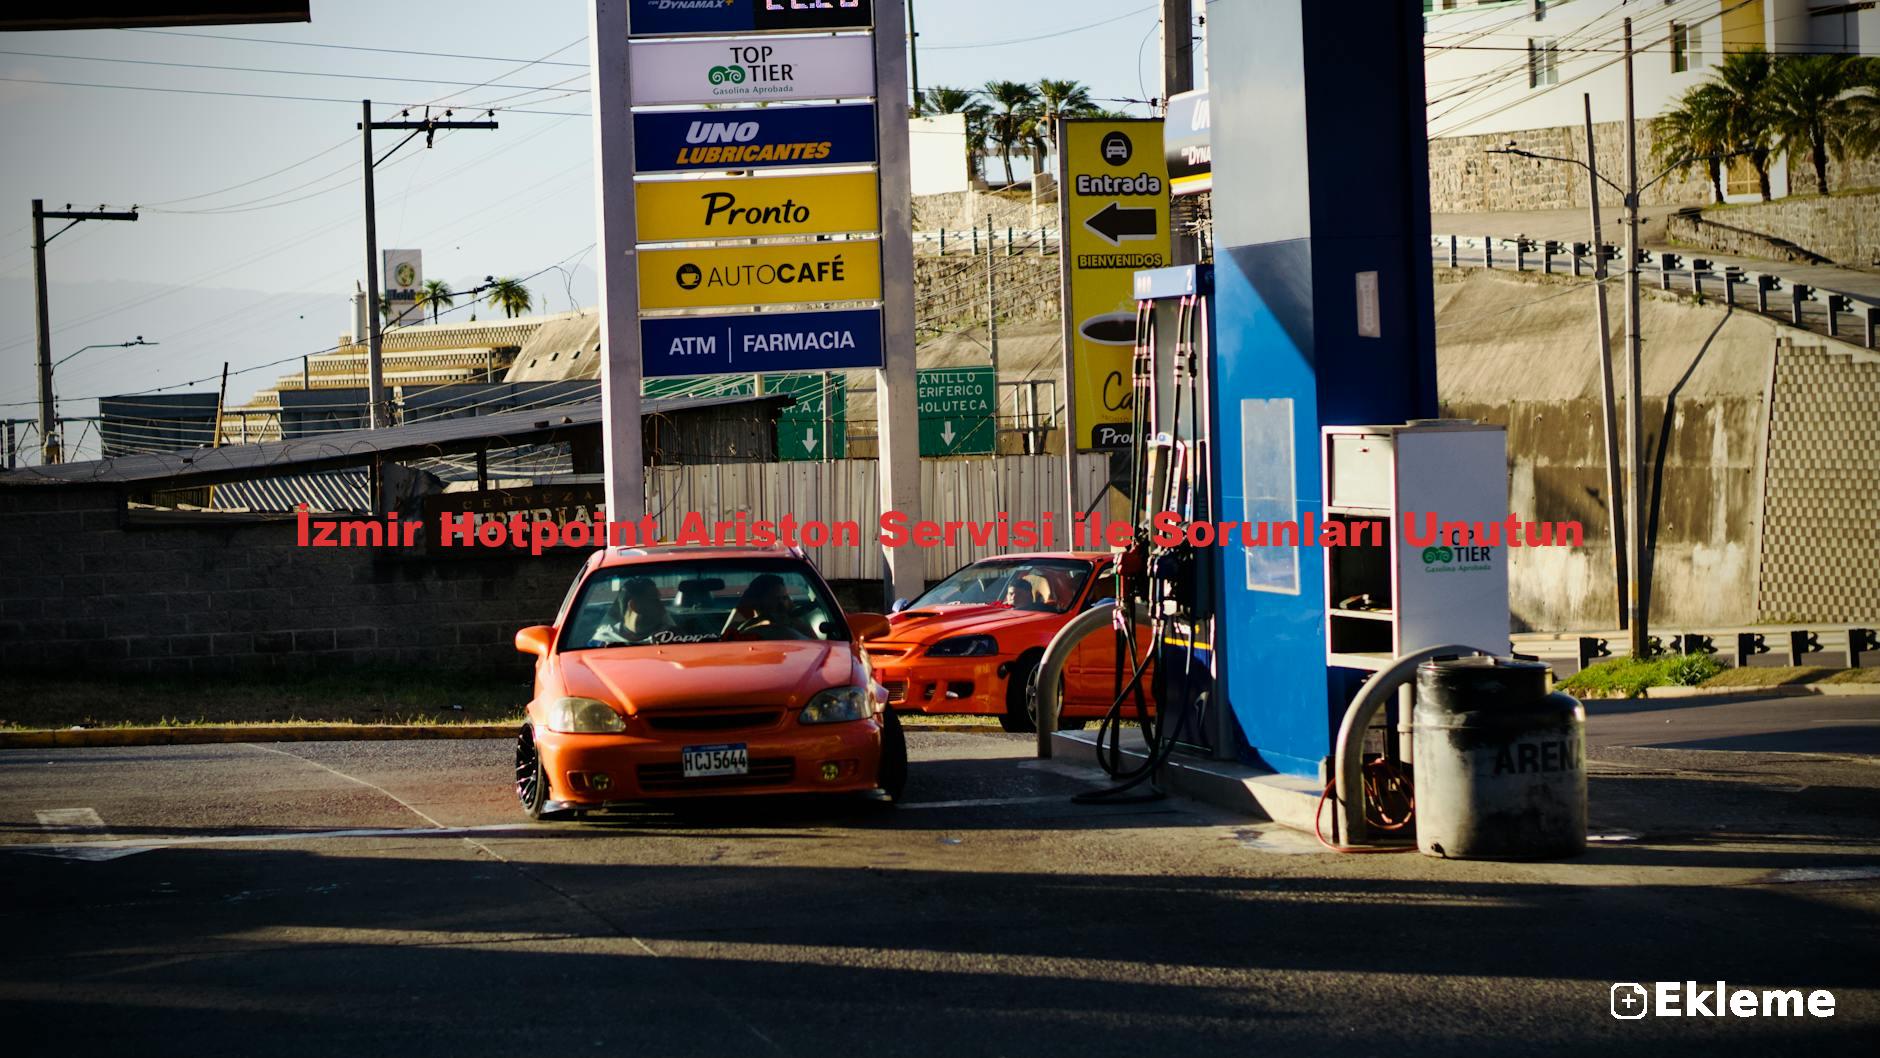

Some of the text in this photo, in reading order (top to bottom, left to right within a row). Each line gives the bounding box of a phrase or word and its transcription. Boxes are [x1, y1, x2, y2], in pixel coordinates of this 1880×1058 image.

[730, 46, 773, 64] TOP
[748, 64, 793, 82] TIER
[713, 85, 793, 96] Gasolina Aprobada
[685, 121, 760, 144] UNO
[676, 142, 831, 165] LUBRICANTES
[1077, 173, 1161, 195] Entrada
[701, 192, 810, 226] Pronto
[1078, 254, 1162, 269] BIENVENIDOS
[707, 255, 845, 287] AUTOCAFÉ
[669, 331, 855, 355] ATM FARMACIA
[919, 372, 976, 385] ANILLO
[919, 384, 983, 398] ERIFERICO
[917, 400, 987, 413] HOLUTECA
[1453, 546, 1491, 562] TIER
[684, 750, 746, 771] HCJ5644
